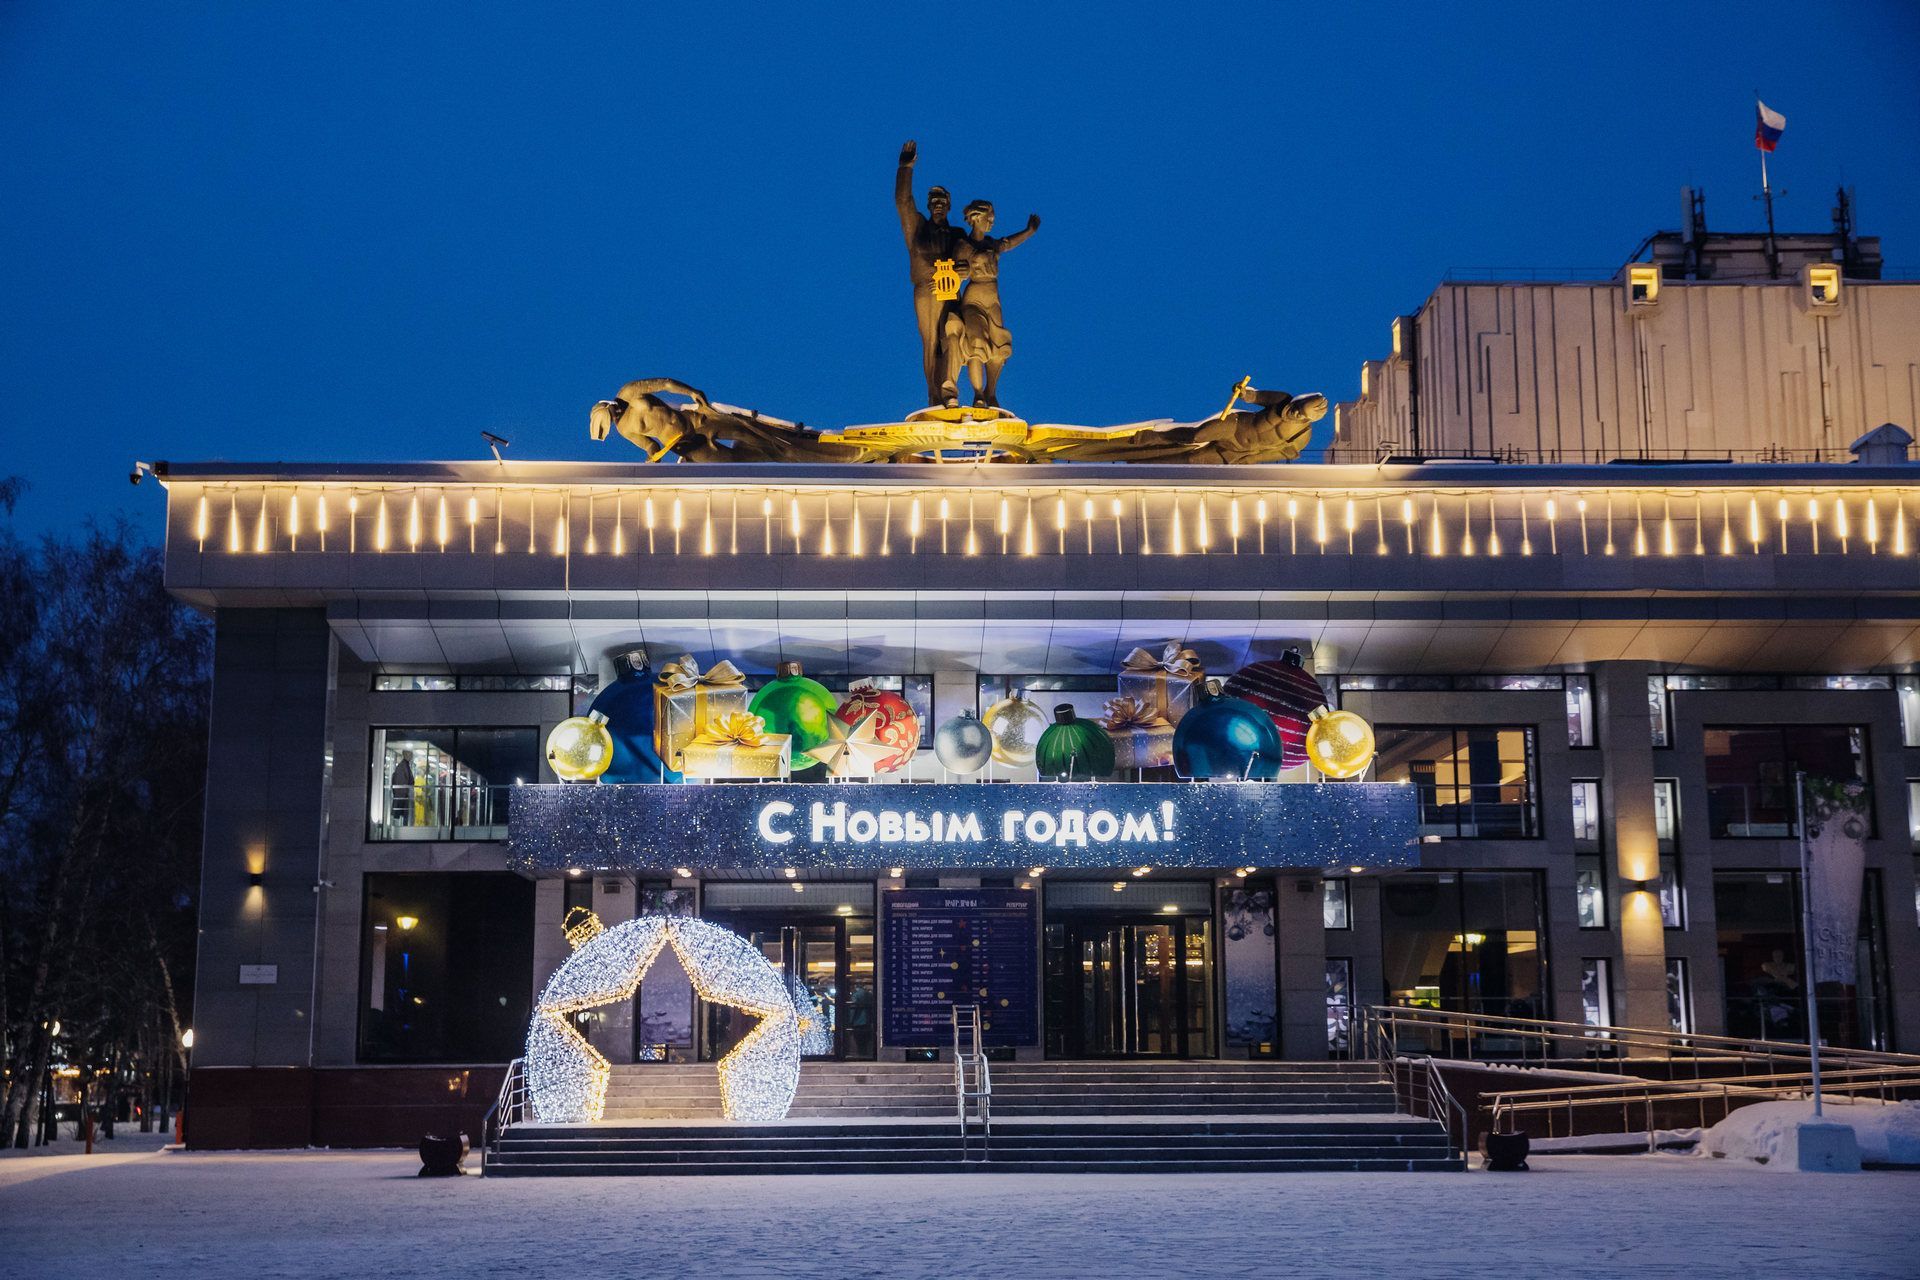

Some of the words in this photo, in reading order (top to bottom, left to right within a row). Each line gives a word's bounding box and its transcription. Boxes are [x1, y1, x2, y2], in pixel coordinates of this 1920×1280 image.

[758, 801, 795, 843] С
[812, 801, 983, 843] Новым
[1003, 800, 1175, 847] годом!
